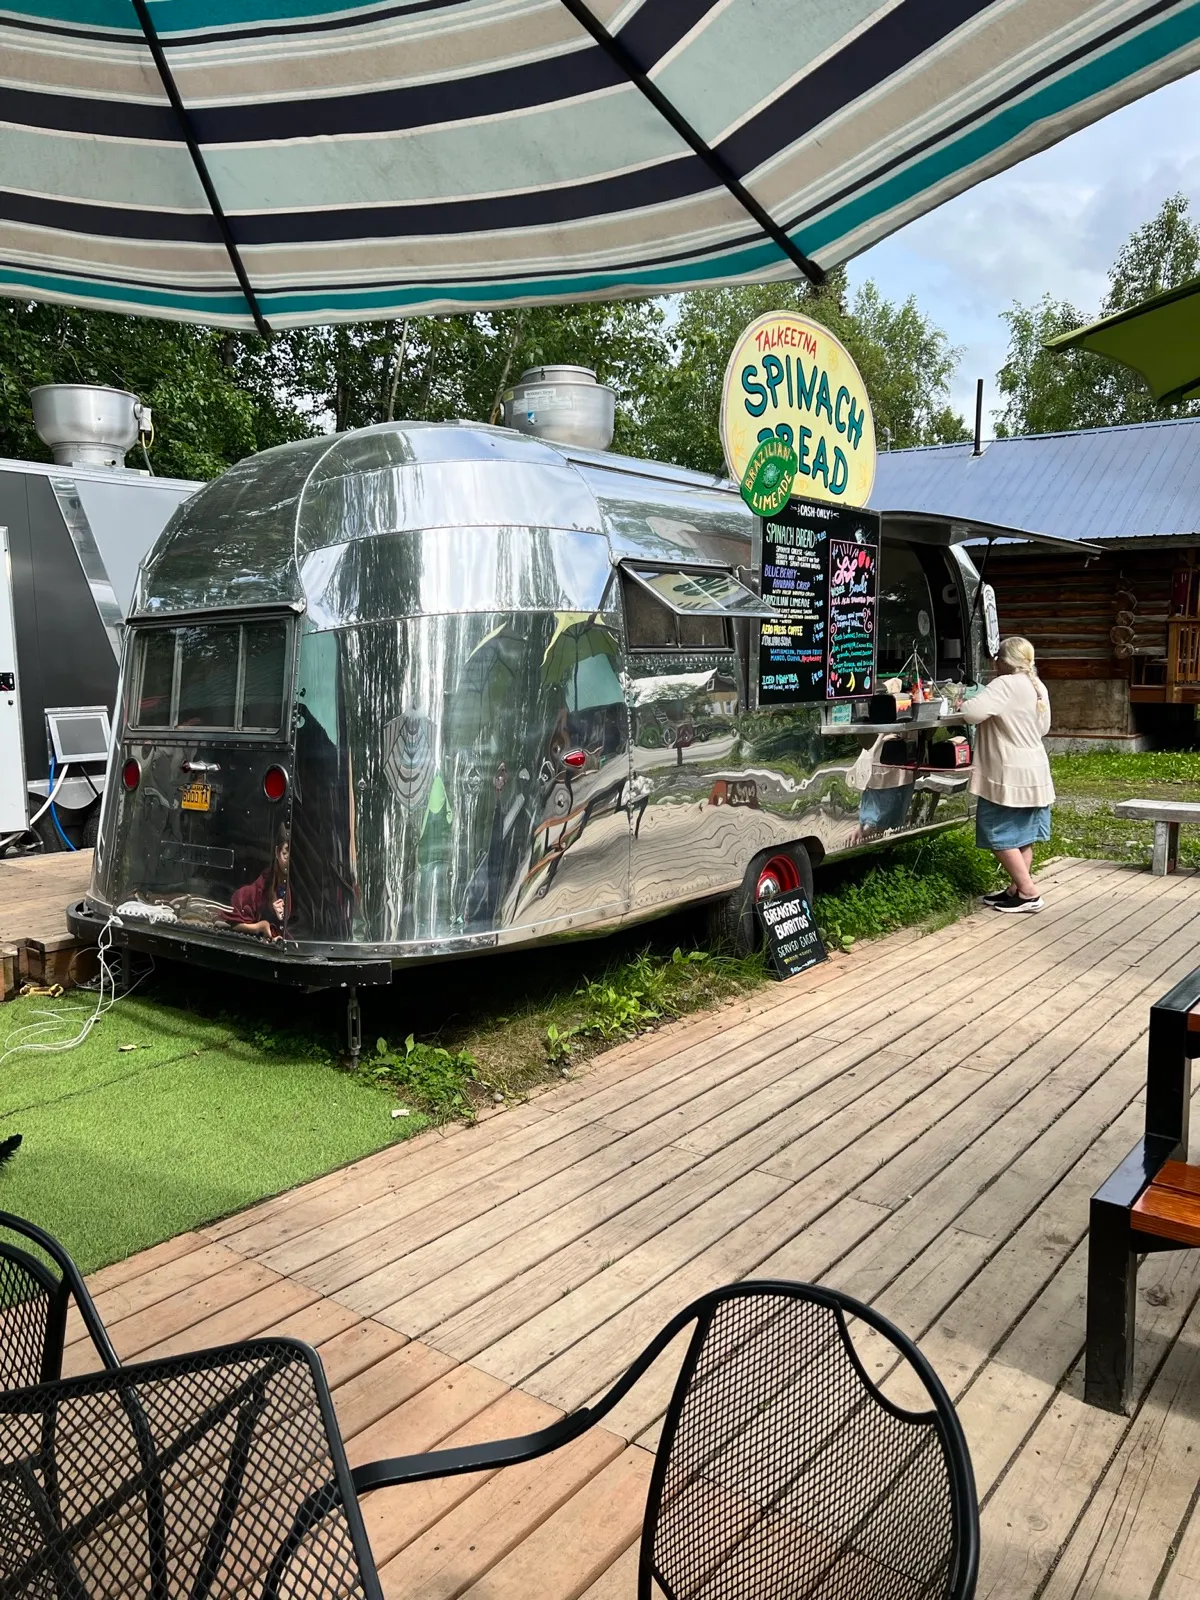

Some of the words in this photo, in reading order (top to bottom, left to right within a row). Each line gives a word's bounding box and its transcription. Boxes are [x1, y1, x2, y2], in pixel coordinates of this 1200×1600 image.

[755, 326, 817, 359] TALKEETNA
[741, 354, 865, 451] SPINACH
[744, 438, 791, 492] BRAZILIAN
[752, 471, 793, 511] LIMEADE
[766, 522, 795, 546] SPINACH
[796, 527, 816, 549] BREAD
[796, 581, 811, 590] CRISP
[790, 596, 811, 608] LIMEADE
[787, 625, 804, 637] COFFEE
[761, 675, 775, 685] ICED
[763, 898, 801, 926] BREAKFAST
[774, 914, 810, 940] BURRITOS
[777, 939, 800, 958] SERVED
[799, 930, 818, 948] EVERY
